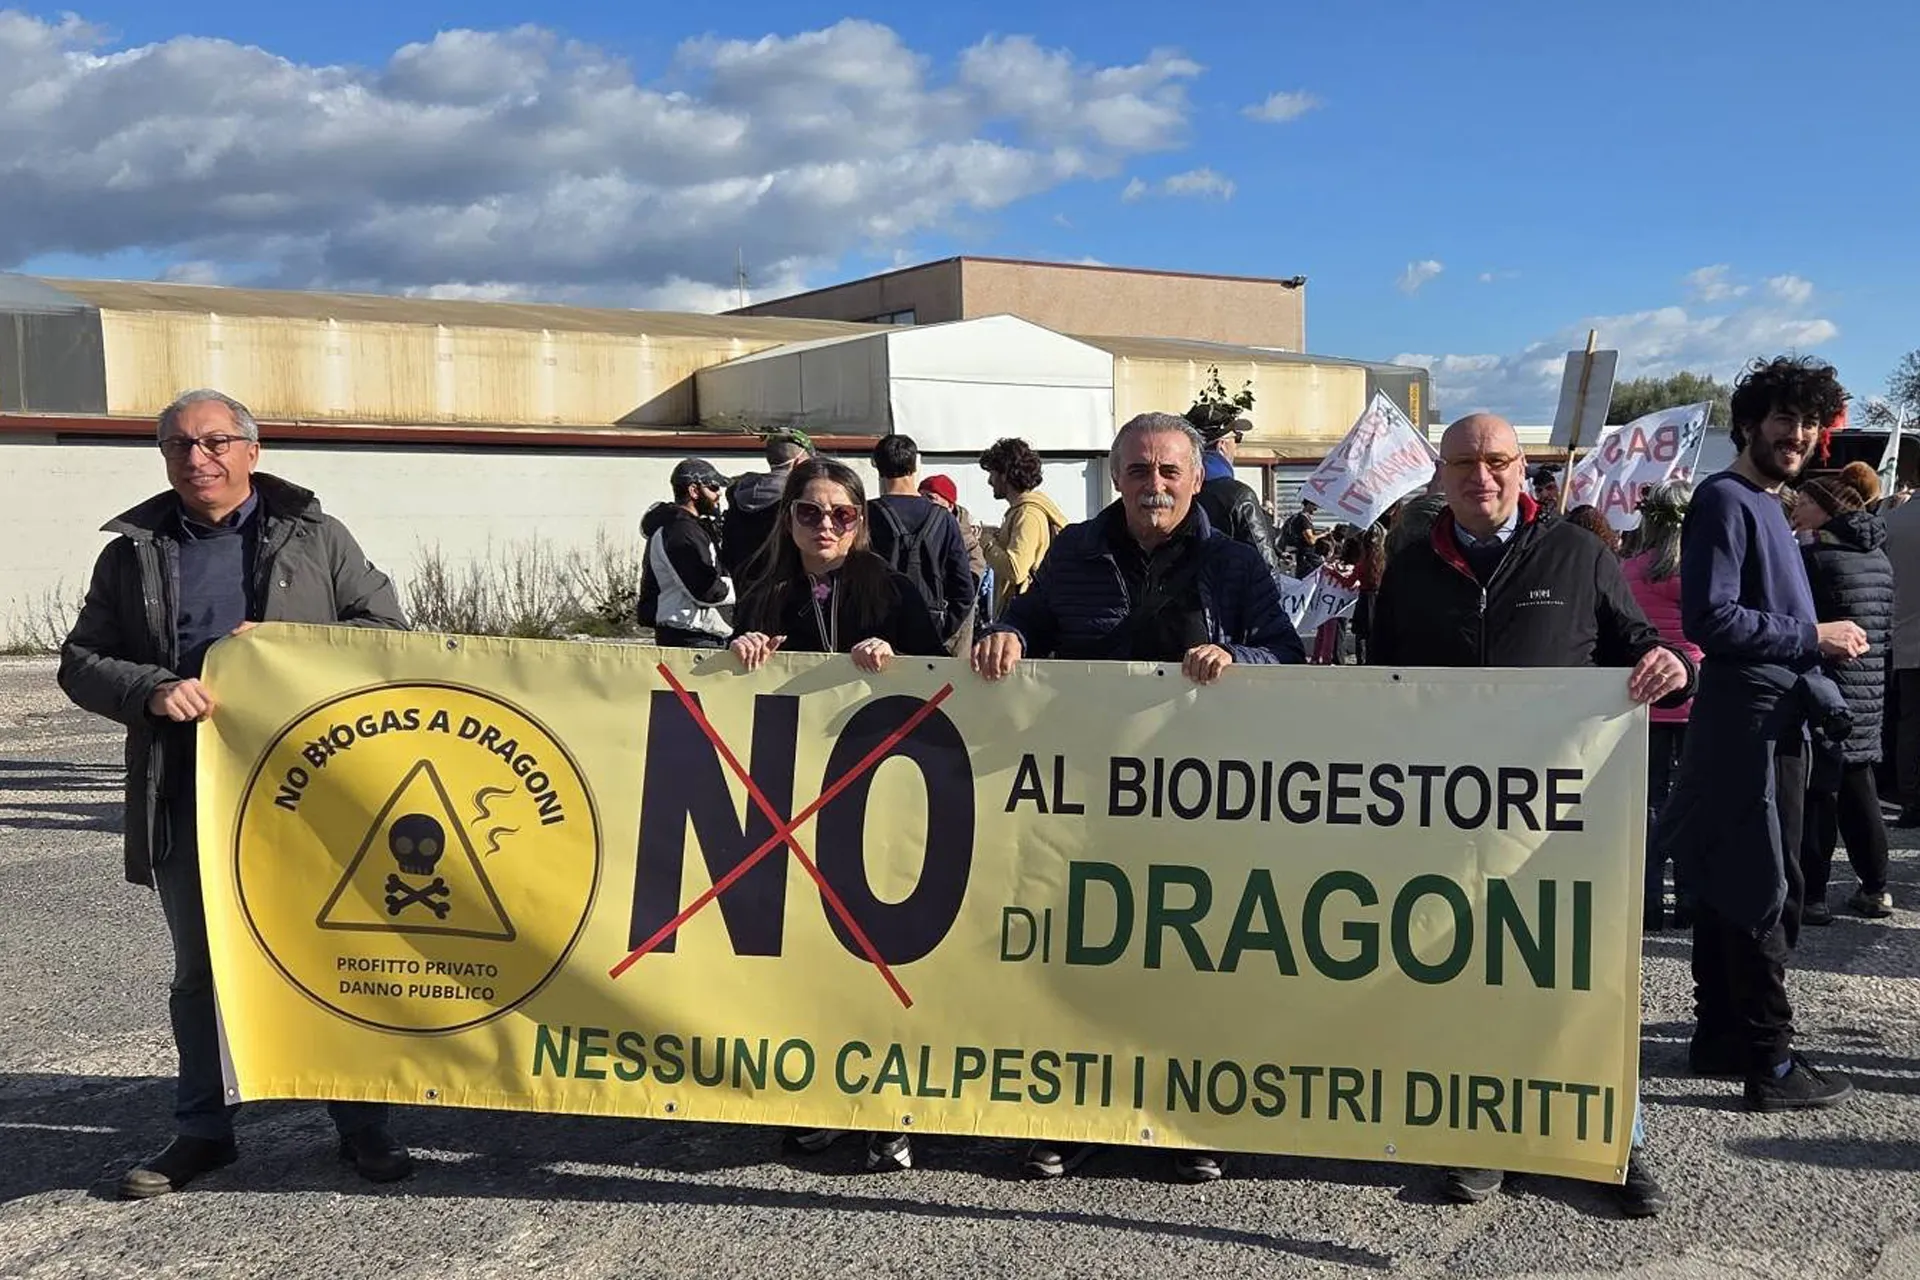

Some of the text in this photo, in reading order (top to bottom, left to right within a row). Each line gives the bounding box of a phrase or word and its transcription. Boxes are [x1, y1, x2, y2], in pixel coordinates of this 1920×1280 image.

[274, 707, 565, 827] NO BIOGAS A DRAGONI
[1004, 753, 1585, 832] AL BIODIGESTORE
[627, 690, 976, 966] NO
[336, 956, 498, 978] PROFITTO PRIVATO
[1000, 860, 1593, 991] DI DRAGONI
[338, 980, 495, 1001] DANNO PUBBLICO
[532, 1024, 1614, 1144] NESSUNO CALPESTI I NOSTRI DIRITTI
